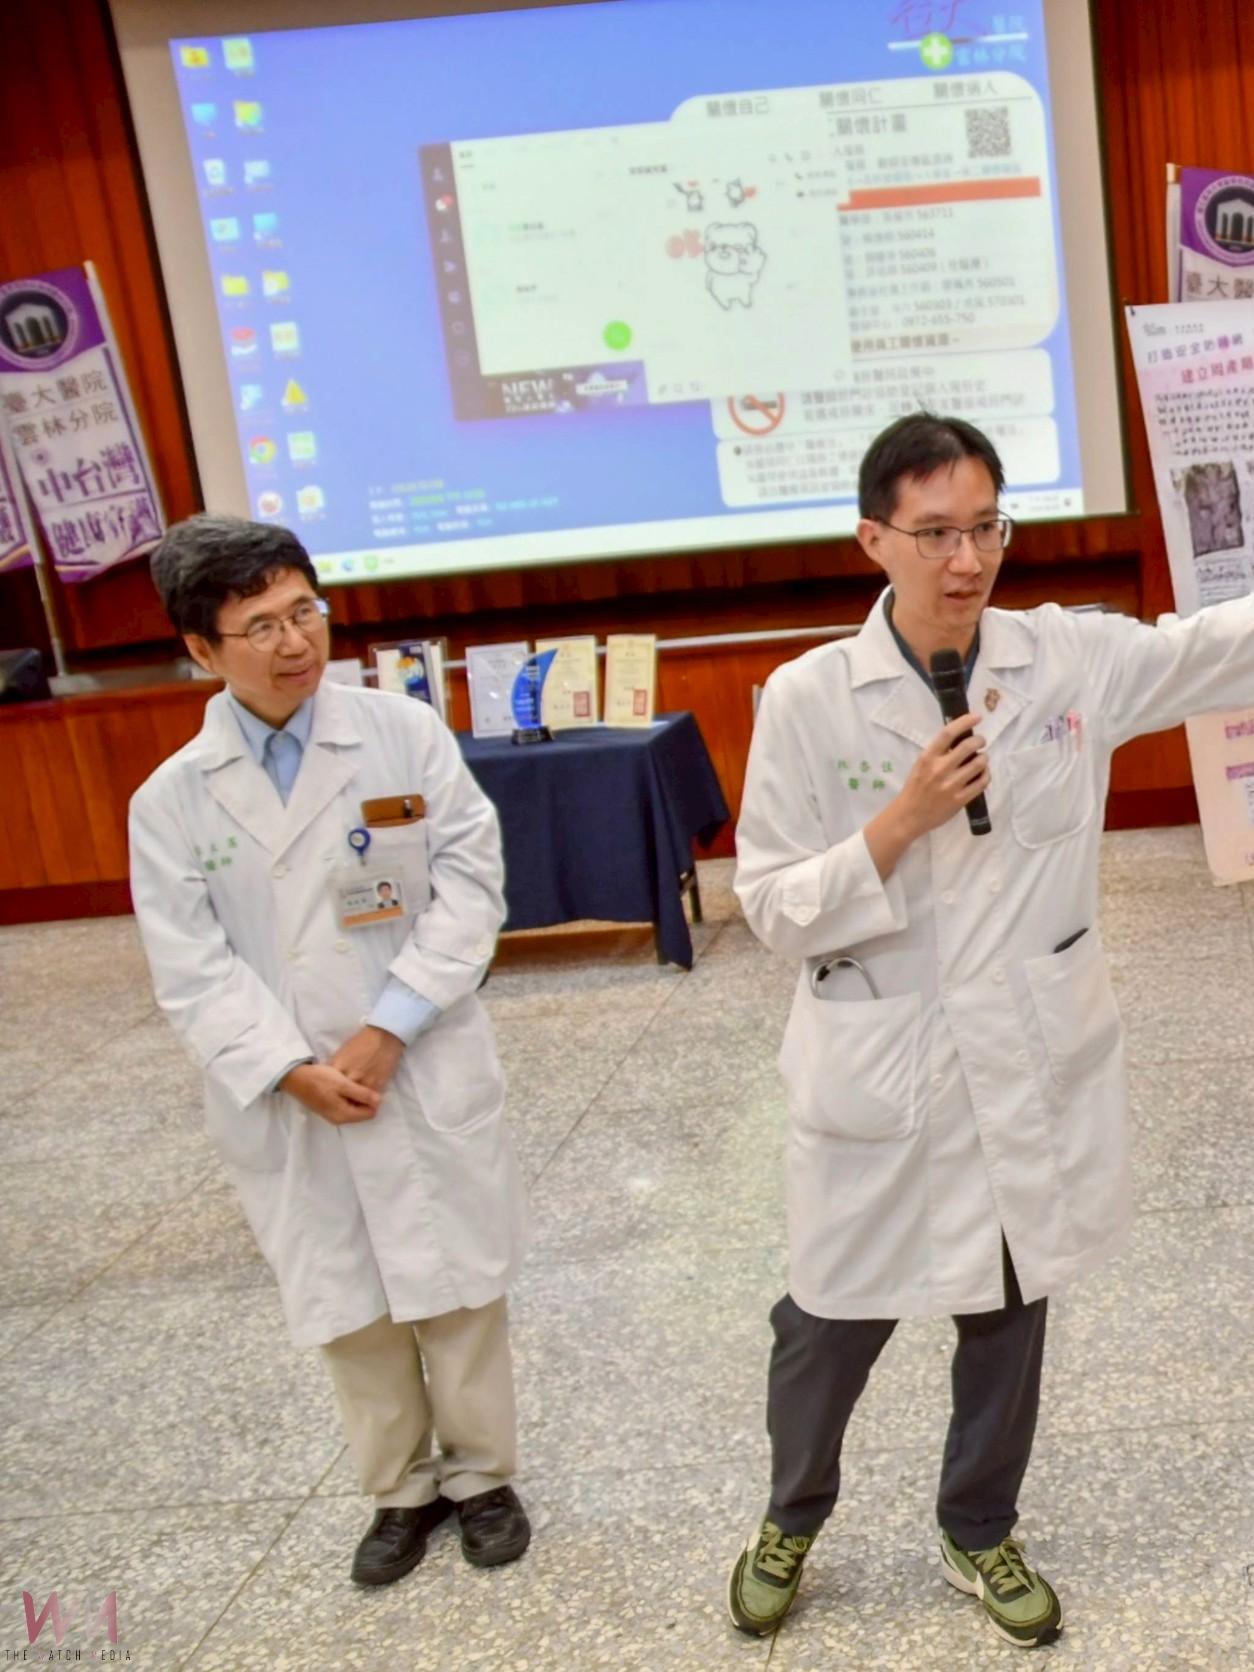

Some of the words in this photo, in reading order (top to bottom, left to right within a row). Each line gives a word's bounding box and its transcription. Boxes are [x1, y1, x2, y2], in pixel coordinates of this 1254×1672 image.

[1, 369, 109, 416] 臺大醫院
[14, 400, 119, 447] 雲林分院
[37, 442, 140, 503] 中台灣
